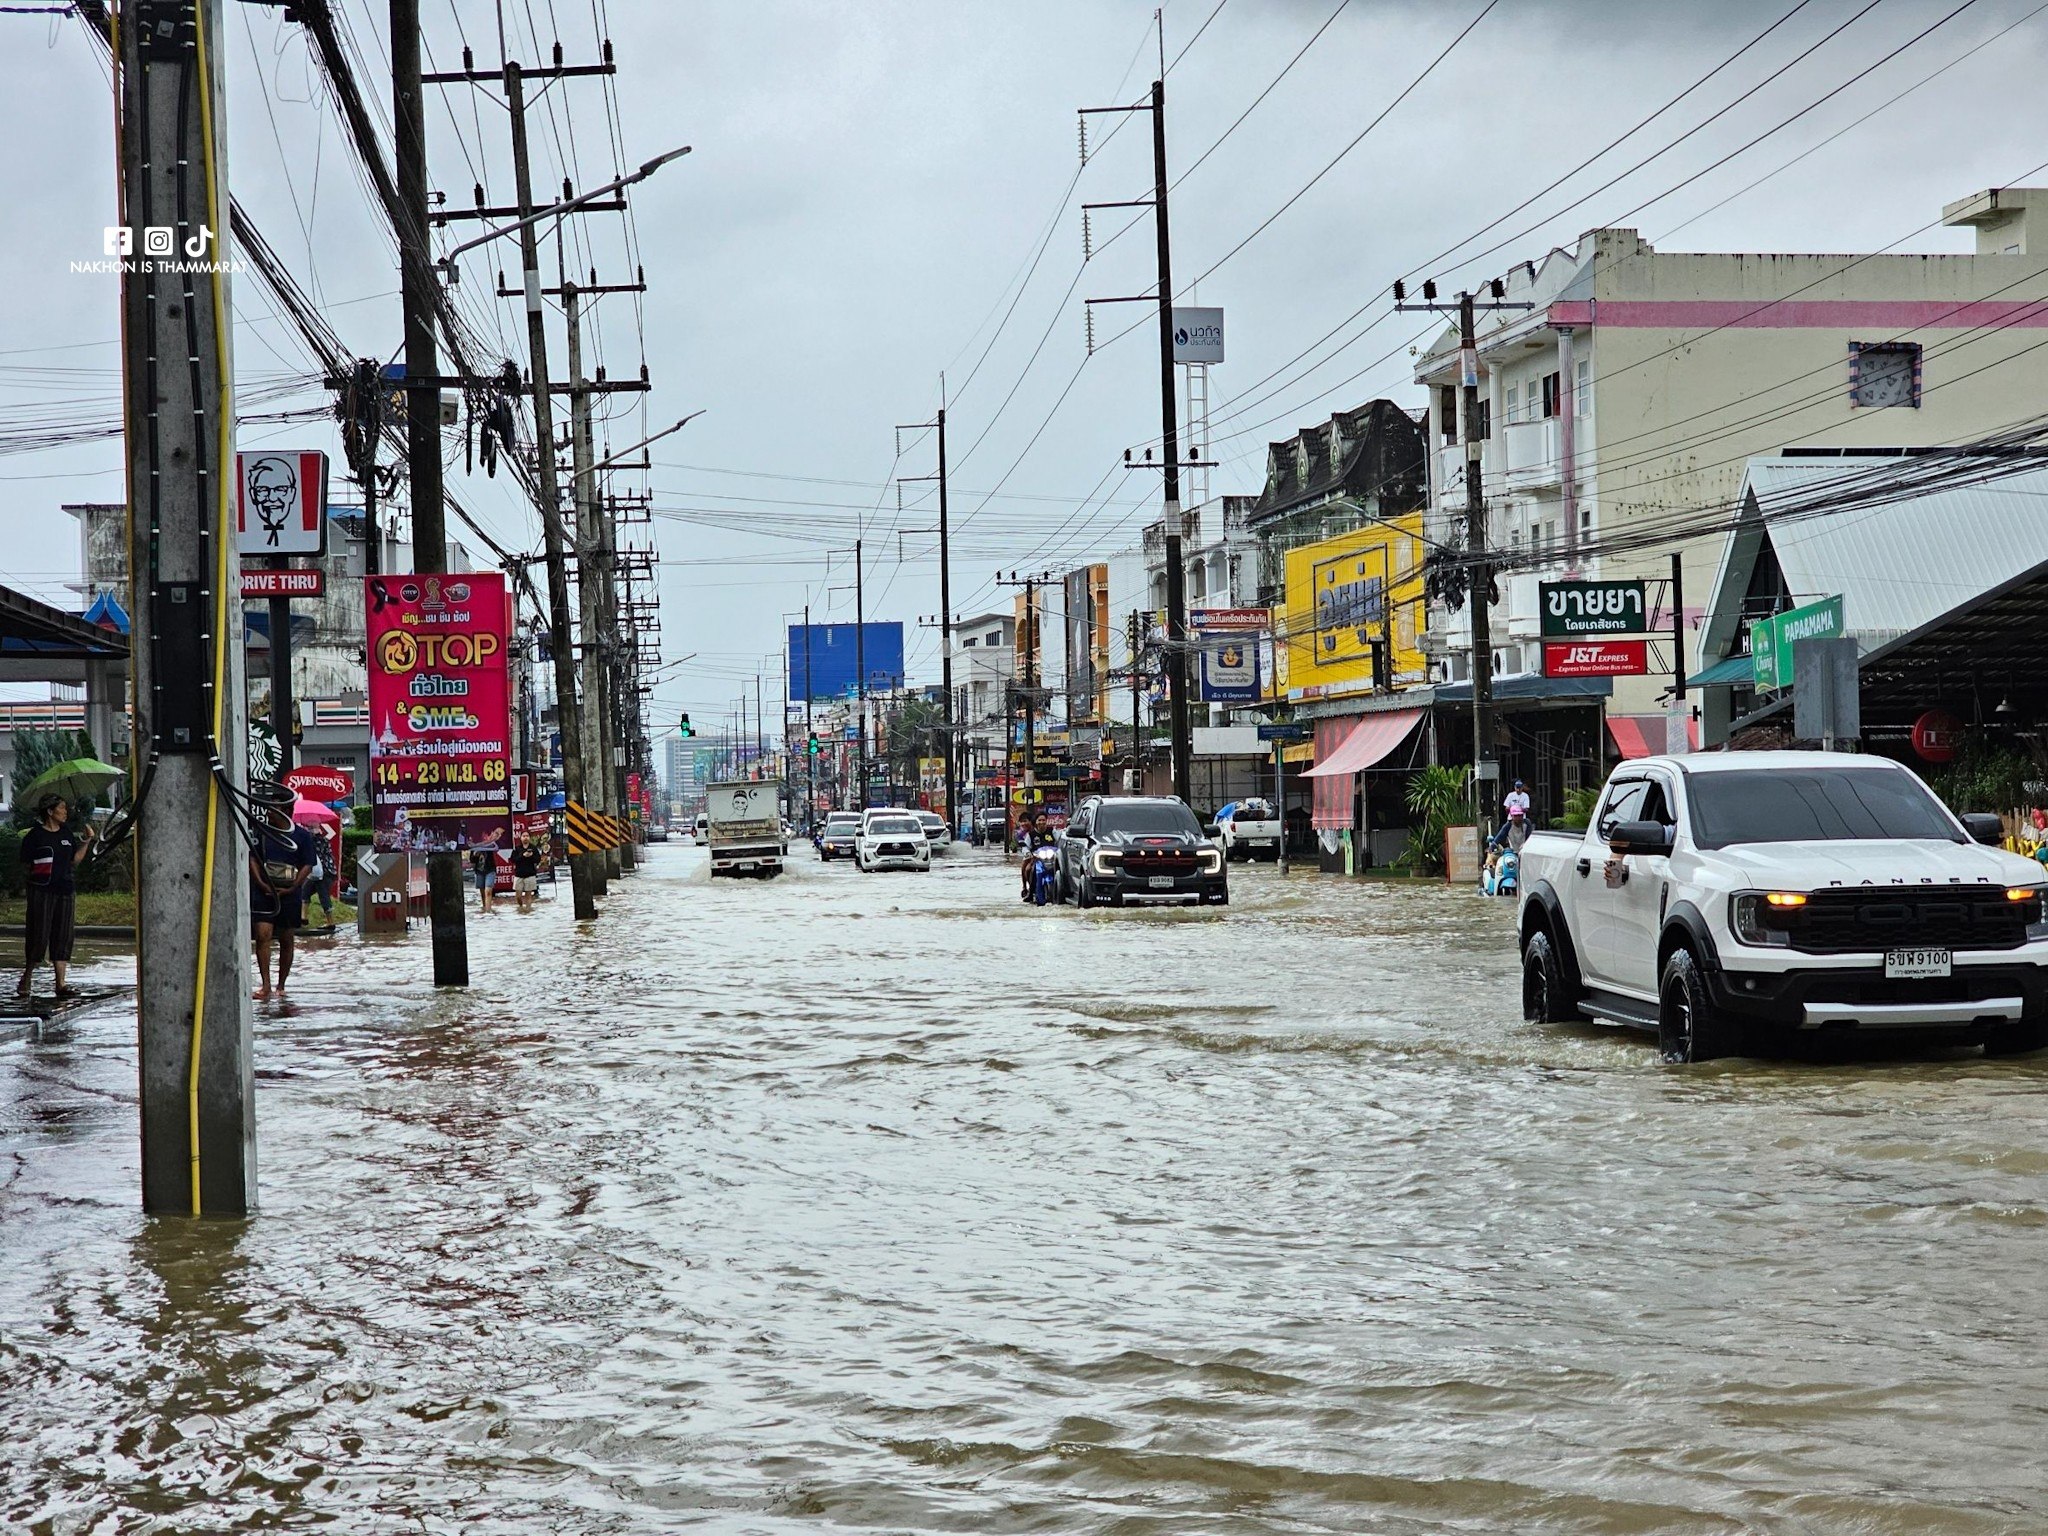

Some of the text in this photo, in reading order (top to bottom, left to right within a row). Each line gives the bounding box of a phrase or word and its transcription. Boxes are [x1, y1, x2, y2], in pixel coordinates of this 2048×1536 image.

[1190, 325, 1221, 337] นวกิจ
[279, 574, 317, 590] THRU
[1548, 588, 1642, 616] ขายยา
[1565, 618, 1626, 630] โดยเภสัชกร
[1784, 610, 1834, 643] PAPA&MAMA
[376, 629, 499, 674] OTOP
[1563, 647, 1629, 663] J&T EXPRESS
[1558, 665, 1579, 673] Express
[1755, 653, 1773, 671] Chang
[409, 674, 468, 696] ทั่วไทย
[396, 701, 479, 732] & SMEs
[377, 763, 399, 785] 14
[417, 762, 440, 784] 23
[445, 763, 478, 783] พ.ย.
[483, 760, 506, 782] 68
[287, 775, 346, 793] SWENSEN'S
[1830, 876, 1990, 886] RANGER
[371, 887, 402, 904] เข้า
[374, 907, 397, 921] IN
[1917, 951, 1948, 966] 9100
